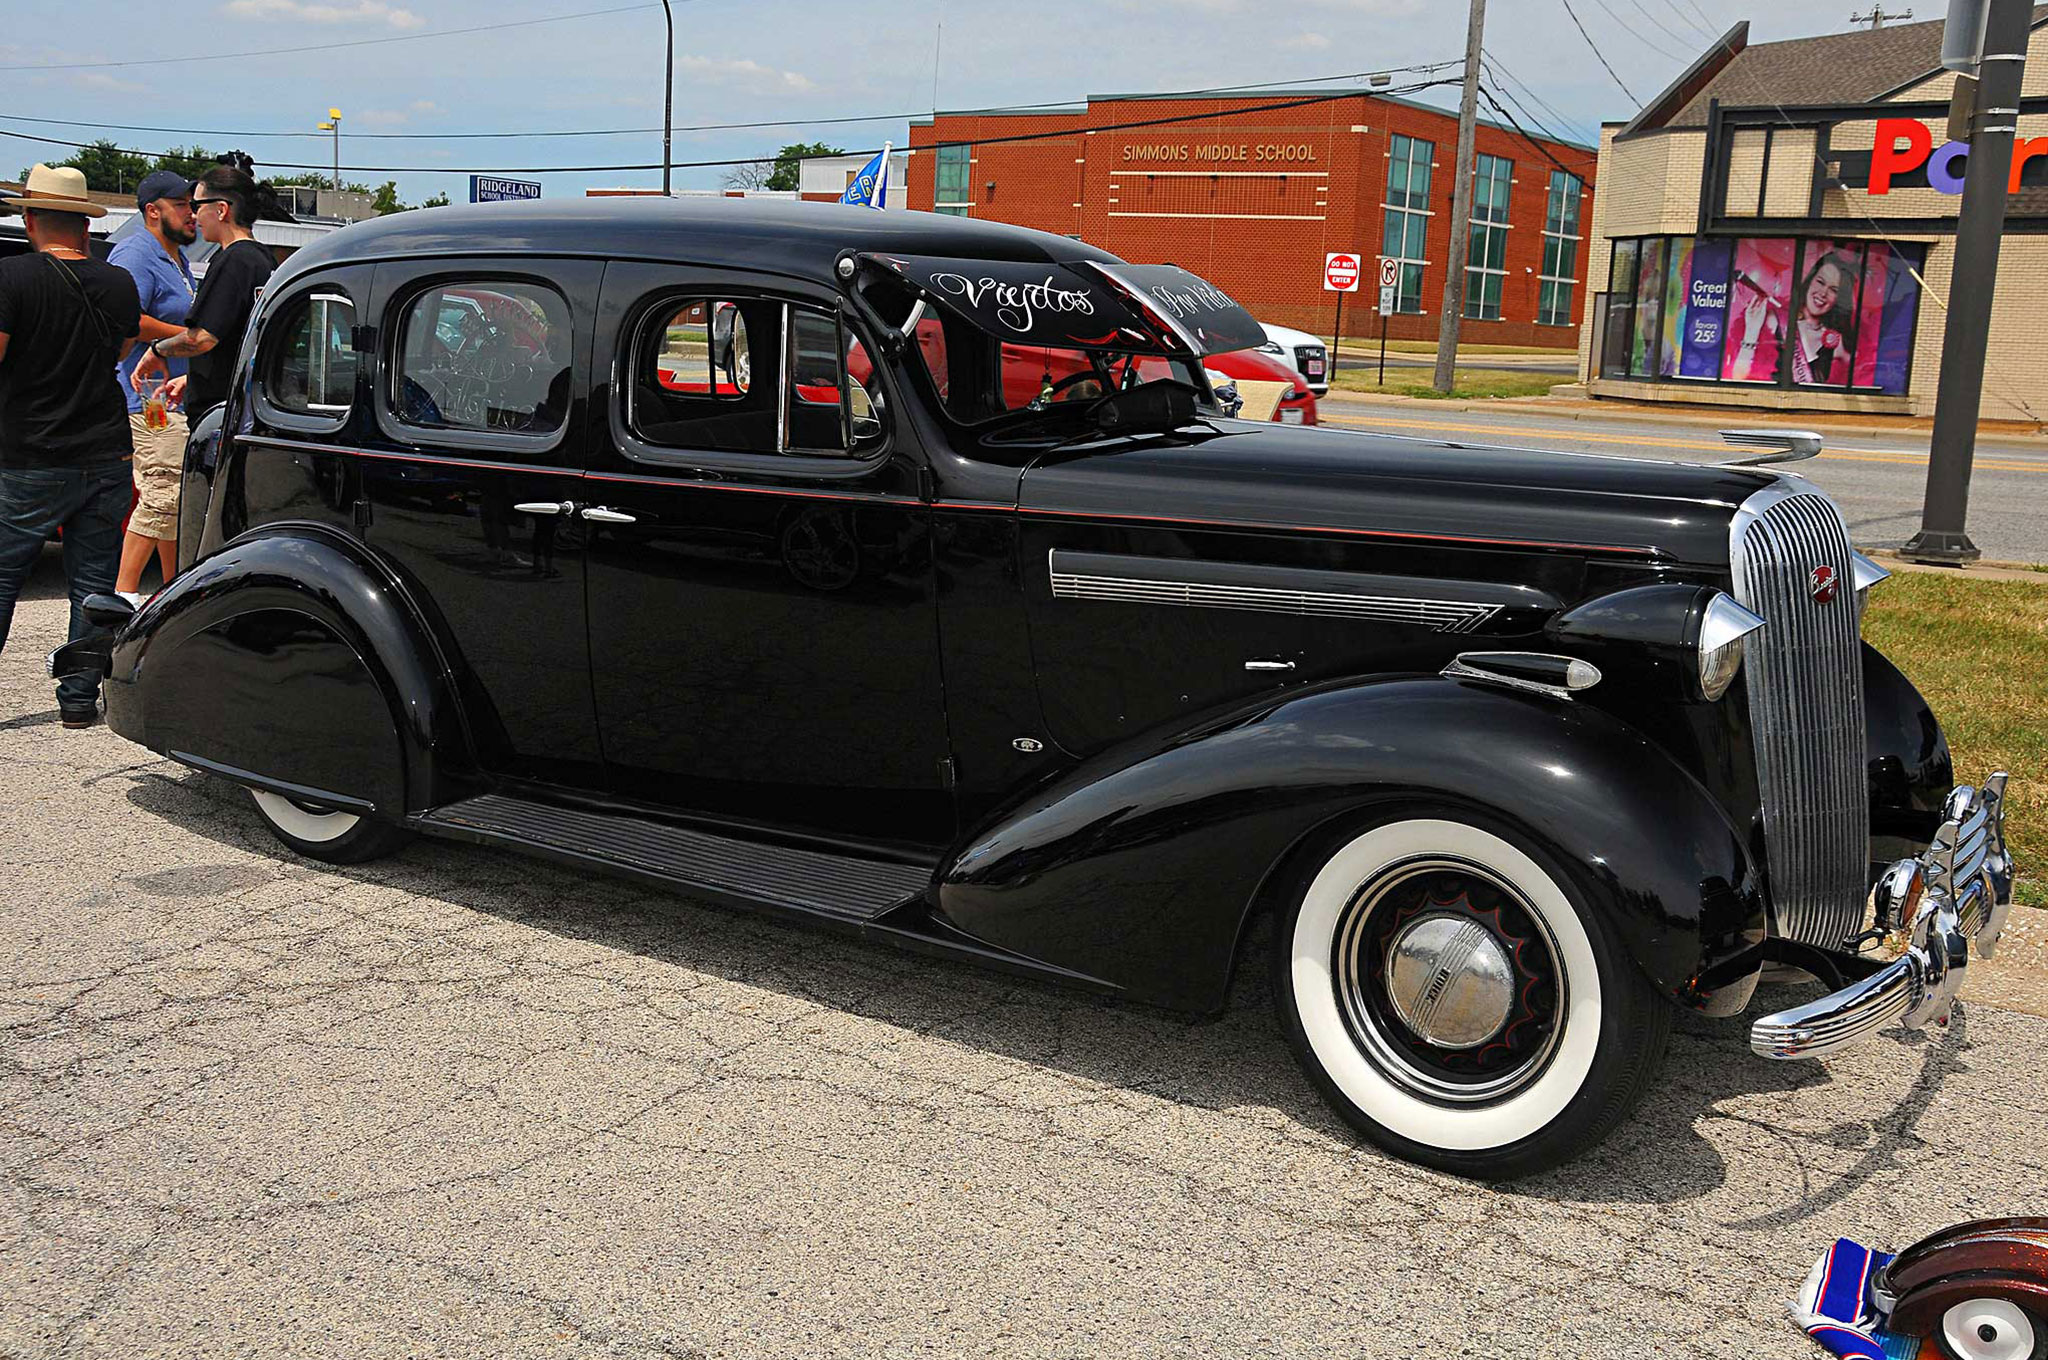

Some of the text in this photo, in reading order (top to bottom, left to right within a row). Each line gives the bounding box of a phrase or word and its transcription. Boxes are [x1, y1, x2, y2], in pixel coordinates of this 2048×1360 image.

[1123, 145, 1317, 162] SIMMONS MIDDLE SCHOOL
[480, 191, 501, 200] SCHOOL
[481, 180, 539, 198] RIDGELAND
[1342, 261, 1354, 269] NOT
[1332, 276, 1351, 284] ENTER
[1693, 280, 1727, 294] Great
[1692, 294, 1727, 308] Value!
